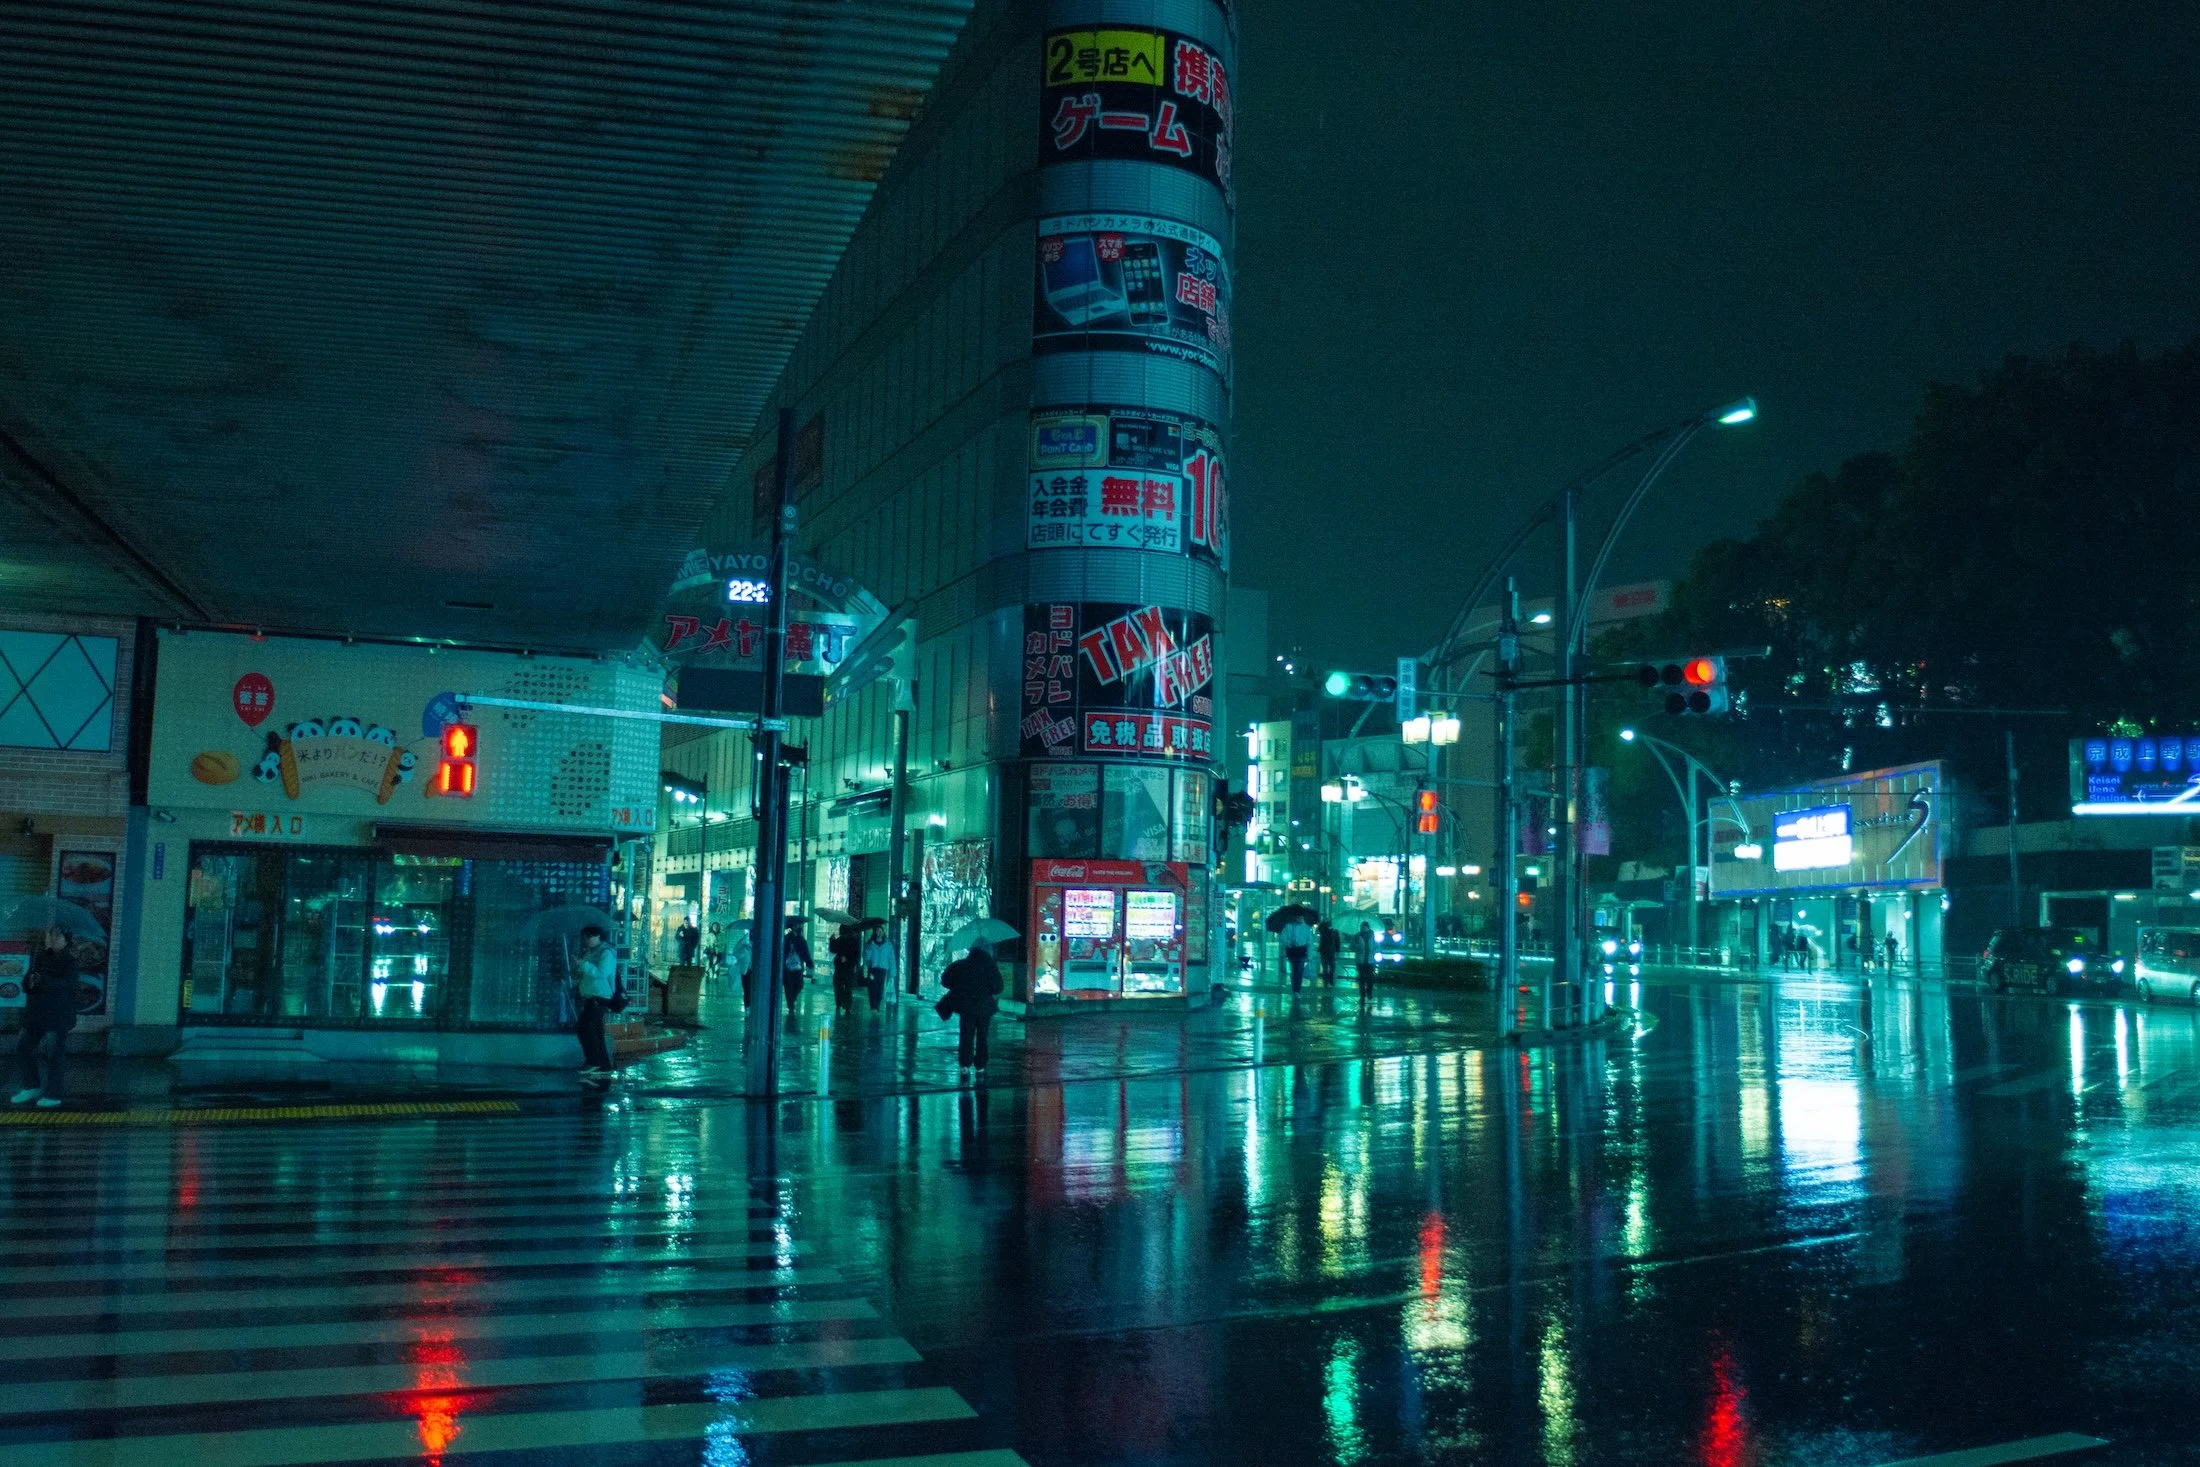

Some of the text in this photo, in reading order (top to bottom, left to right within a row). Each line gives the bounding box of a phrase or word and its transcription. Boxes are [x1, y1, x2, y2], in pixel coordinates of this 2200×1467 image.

[1050, 38, 1156, 81] 2号店へ
[1051, 93, 1193, 158] ゲーム
[1099, 239, 1122, 249] スマホ
[1101, 248, 1119, 259] から
[1050, 428, 1084, 441] GOLD
[1165, 463, 1180, 471] VISA
[1033, 476, 1088, 498] 入会金
[1032, 498, 1088, 519] 年会費
[1101, 476, 1175, 522] 無料
[1031, 522, 1178, 548] 店頭にてすぐ発行
[728, 580, 769, 603] 22:2
[1048, 605, 1073, 704] ヨドバシ
[1079, 605, 1180, 686] TAX
[1026, 631, 1047, 705] カメラ
[1153, 633, 1213, 709] FREE
[1021, 706, 1055, 740] TAX
[1040, 716, 1076, 749] FREE
[1089, 720, 1211, 754] 免税品取扱店
[2088, 776, 2121, 785] Keisei
[2088, 785, 2116, 793] Ueno
[2089, 794, 2128, 803] Station
[232, 812, 303, 835] アメ横入口
[1143, 822, 1165, 838] VISA
[1050, 864, 1085, 878] Coca-Cola
